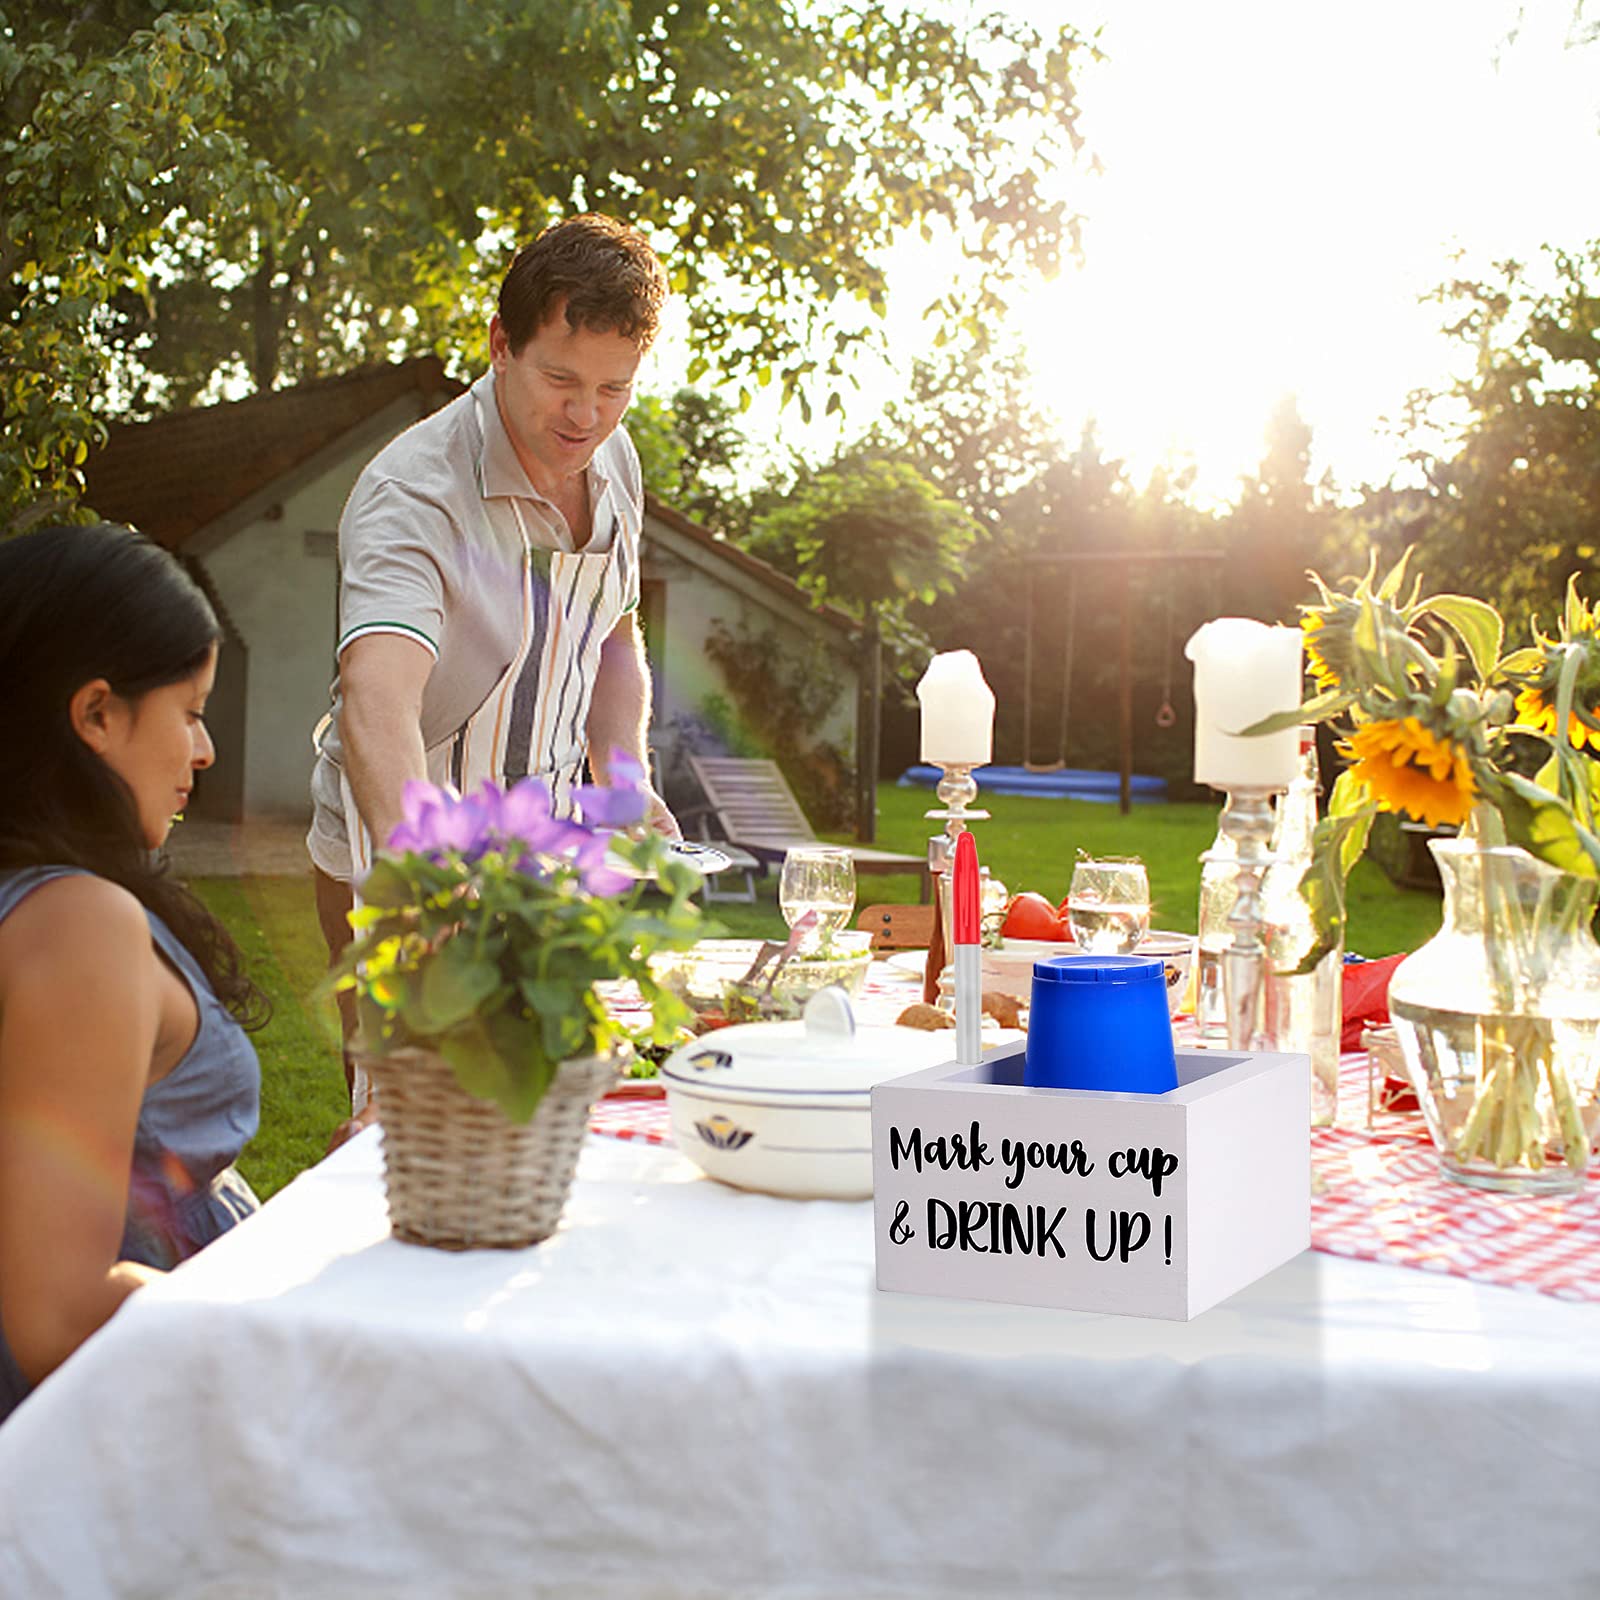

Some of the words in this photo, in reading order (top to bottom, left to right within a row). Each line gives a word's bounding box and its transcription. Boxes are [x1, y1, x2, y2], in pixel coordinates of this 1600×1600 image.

[889, 1120, 995, 1174] Mark
[1001, 1138, 1095, 1190] your
[1108, 1146, 1179, 1198] cup
[889, 1199, 916, 1246] &
[927, 1198, 1067, 1260] DRINK
